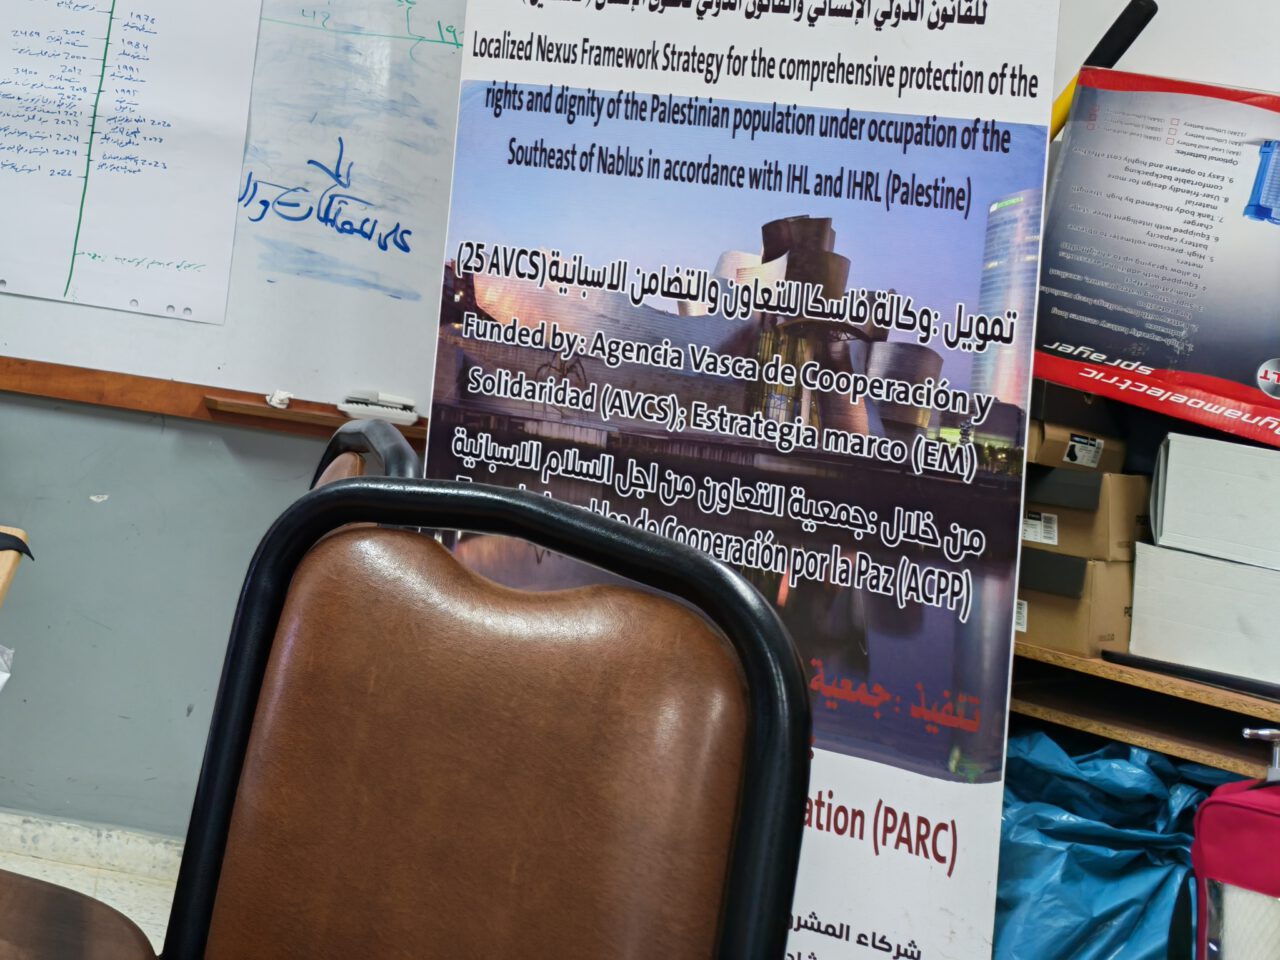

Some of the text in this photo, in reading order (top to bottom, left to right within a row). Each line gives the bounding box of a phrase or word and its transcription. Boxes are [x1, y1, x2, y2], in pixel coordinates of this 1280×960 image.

[472, 30, 1039, 98] Localized Nexus Framework Strategy for the comprehensive protection of the
[485, 80, 1011, 154] rights and dignity of the Palestinian population under occupation of the
[507, 136, 972, 219] Southeast of Nablus in accordance with IHL and IHRL (Palestine)
[1124, 166, 1223, 190] comfortable backpacking
[1165, 164, 1195, 175] operate
[1208, 156, 1238, 166] Optional
[1208, 171, 1225, 182] Easy
[1135, 199, 1214, 221] Tank body thickened
[1141, 180, 1220, 201] User-friendly design
[1185, 200, 1218, 211] material
[1146, 231, 1208, 250] battery capacity
[1154, 223, 1210, 241] Equipped with
[1183, 219, 1213, 230] charger
[629, 265, 719, 315] والتضامن
[722, 278, 802, 320] للتعاون
[803, 283, 869, 324] فاسكا
[943, 303, 1017, 352] تمويل
[463, 312, 992, 425] Funded by: Agencia Vasca de Cooperación y
[1043, 342, 1154, 376] sprayer
[1079, 368, 1280, 435] ynamoelectric
[468, 367, 977, 483] Solidaridad (AVCS); Estrategia marco (EM)
[541, 447, 614, 483] السلام
[660, 469, 695, 506] من
[698, 477, 785, 516] التعاون
[881, 507, 941, 547] خلال
[944, 522, 985, 562] من
[789, 547, 830, 588] por
[830, 545, 852, 586] la
[854, 551, 895, 595] Paz
[897, 556, 972, 623] (ACPP)
[910, 682, 981, 734] تنفيذ
[873, 798, 958, 878] (PARC)
